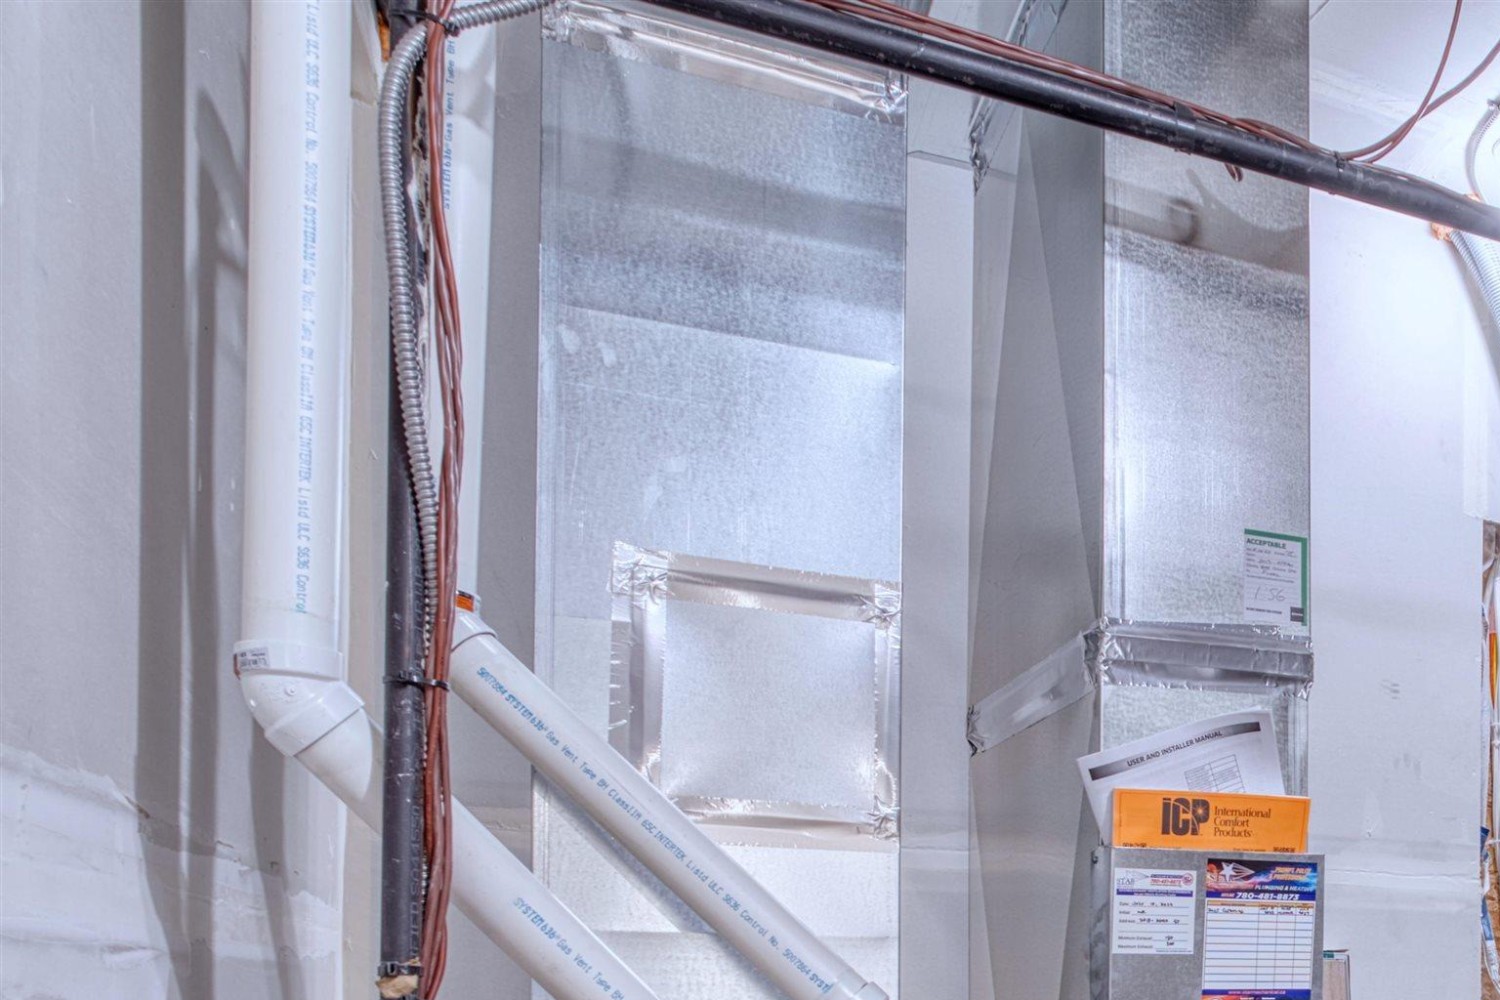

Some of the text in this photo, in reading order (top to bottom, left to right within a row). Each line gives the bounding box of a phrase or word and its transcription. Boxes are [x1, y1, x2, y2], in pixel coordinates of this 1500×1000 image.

[297, 522, 309, 540] ULC
[1247, 538, 1287, 549] ACCEPTABLE
[296, 546, 308, 569] S636
[1126, 729, 1222, 766] USER AND INSTALLER MANUAL
[1214, 806, 1271, 818] International
[1213, 817, 1249, 827] Comfort
[544, 730, 561, 747] Gas
[559, 744, 579, 763] Vent
[652, 830, 687, 862] INTERTEK
[685, 859, 710, 882] Listd
[707, 879, 723, 895] ULC
[721, 893, 741, 912] S636
[738, 909, 769, 937] Control
[767, 935, 783, 950] No.
[1236, 892, 1299, 900] 780-481-8873
[555, 938, 573, 956] Gas
[571, 953, 593, 974] Vent
[590, 971, 613, 993] Type
